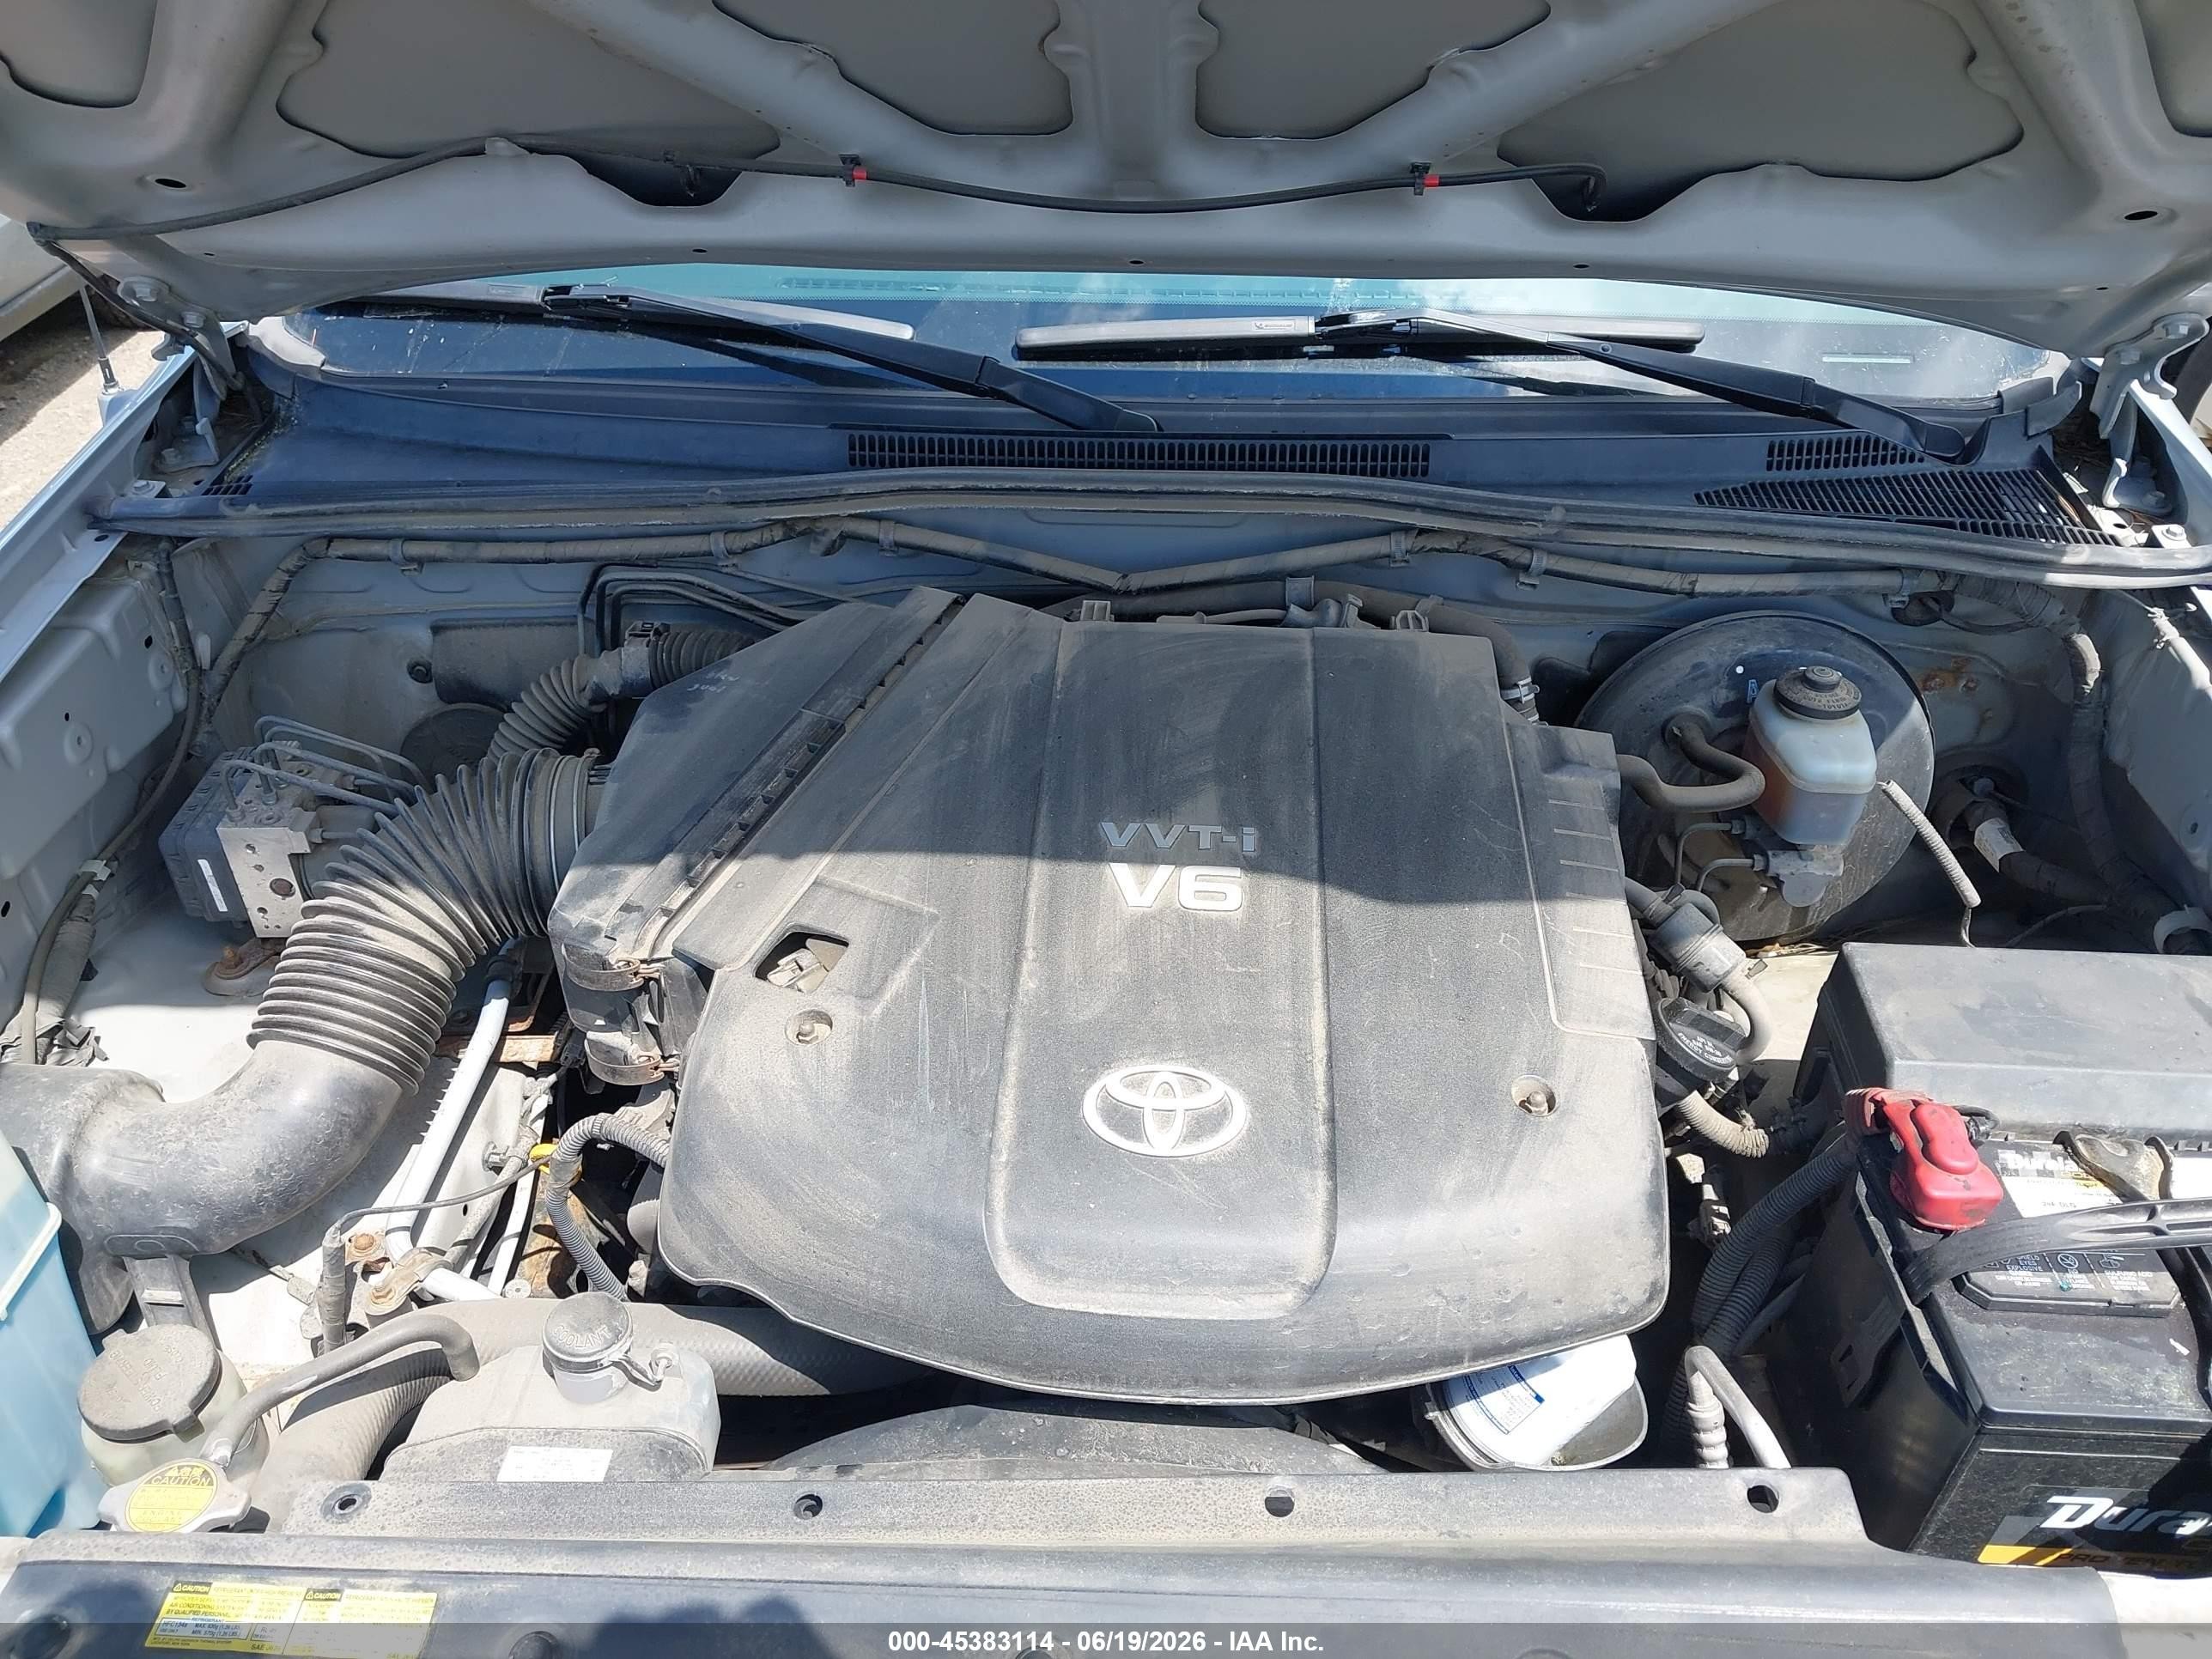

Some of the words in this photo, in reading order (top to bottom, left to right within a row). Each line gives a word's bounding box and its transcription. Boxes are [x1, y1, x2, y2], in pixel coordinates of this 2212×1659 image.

[1100, 822, 1256, 852] VVT-i
[1109, 862, 1243, 912] V6
[552, 1324, 612, 1348] COOLANT
[151, 1475, 211, 1487] CAUTION
[2039, 1495, 2212, 1534] Dura
[181, 1584, 210, 1593] CAUTION
